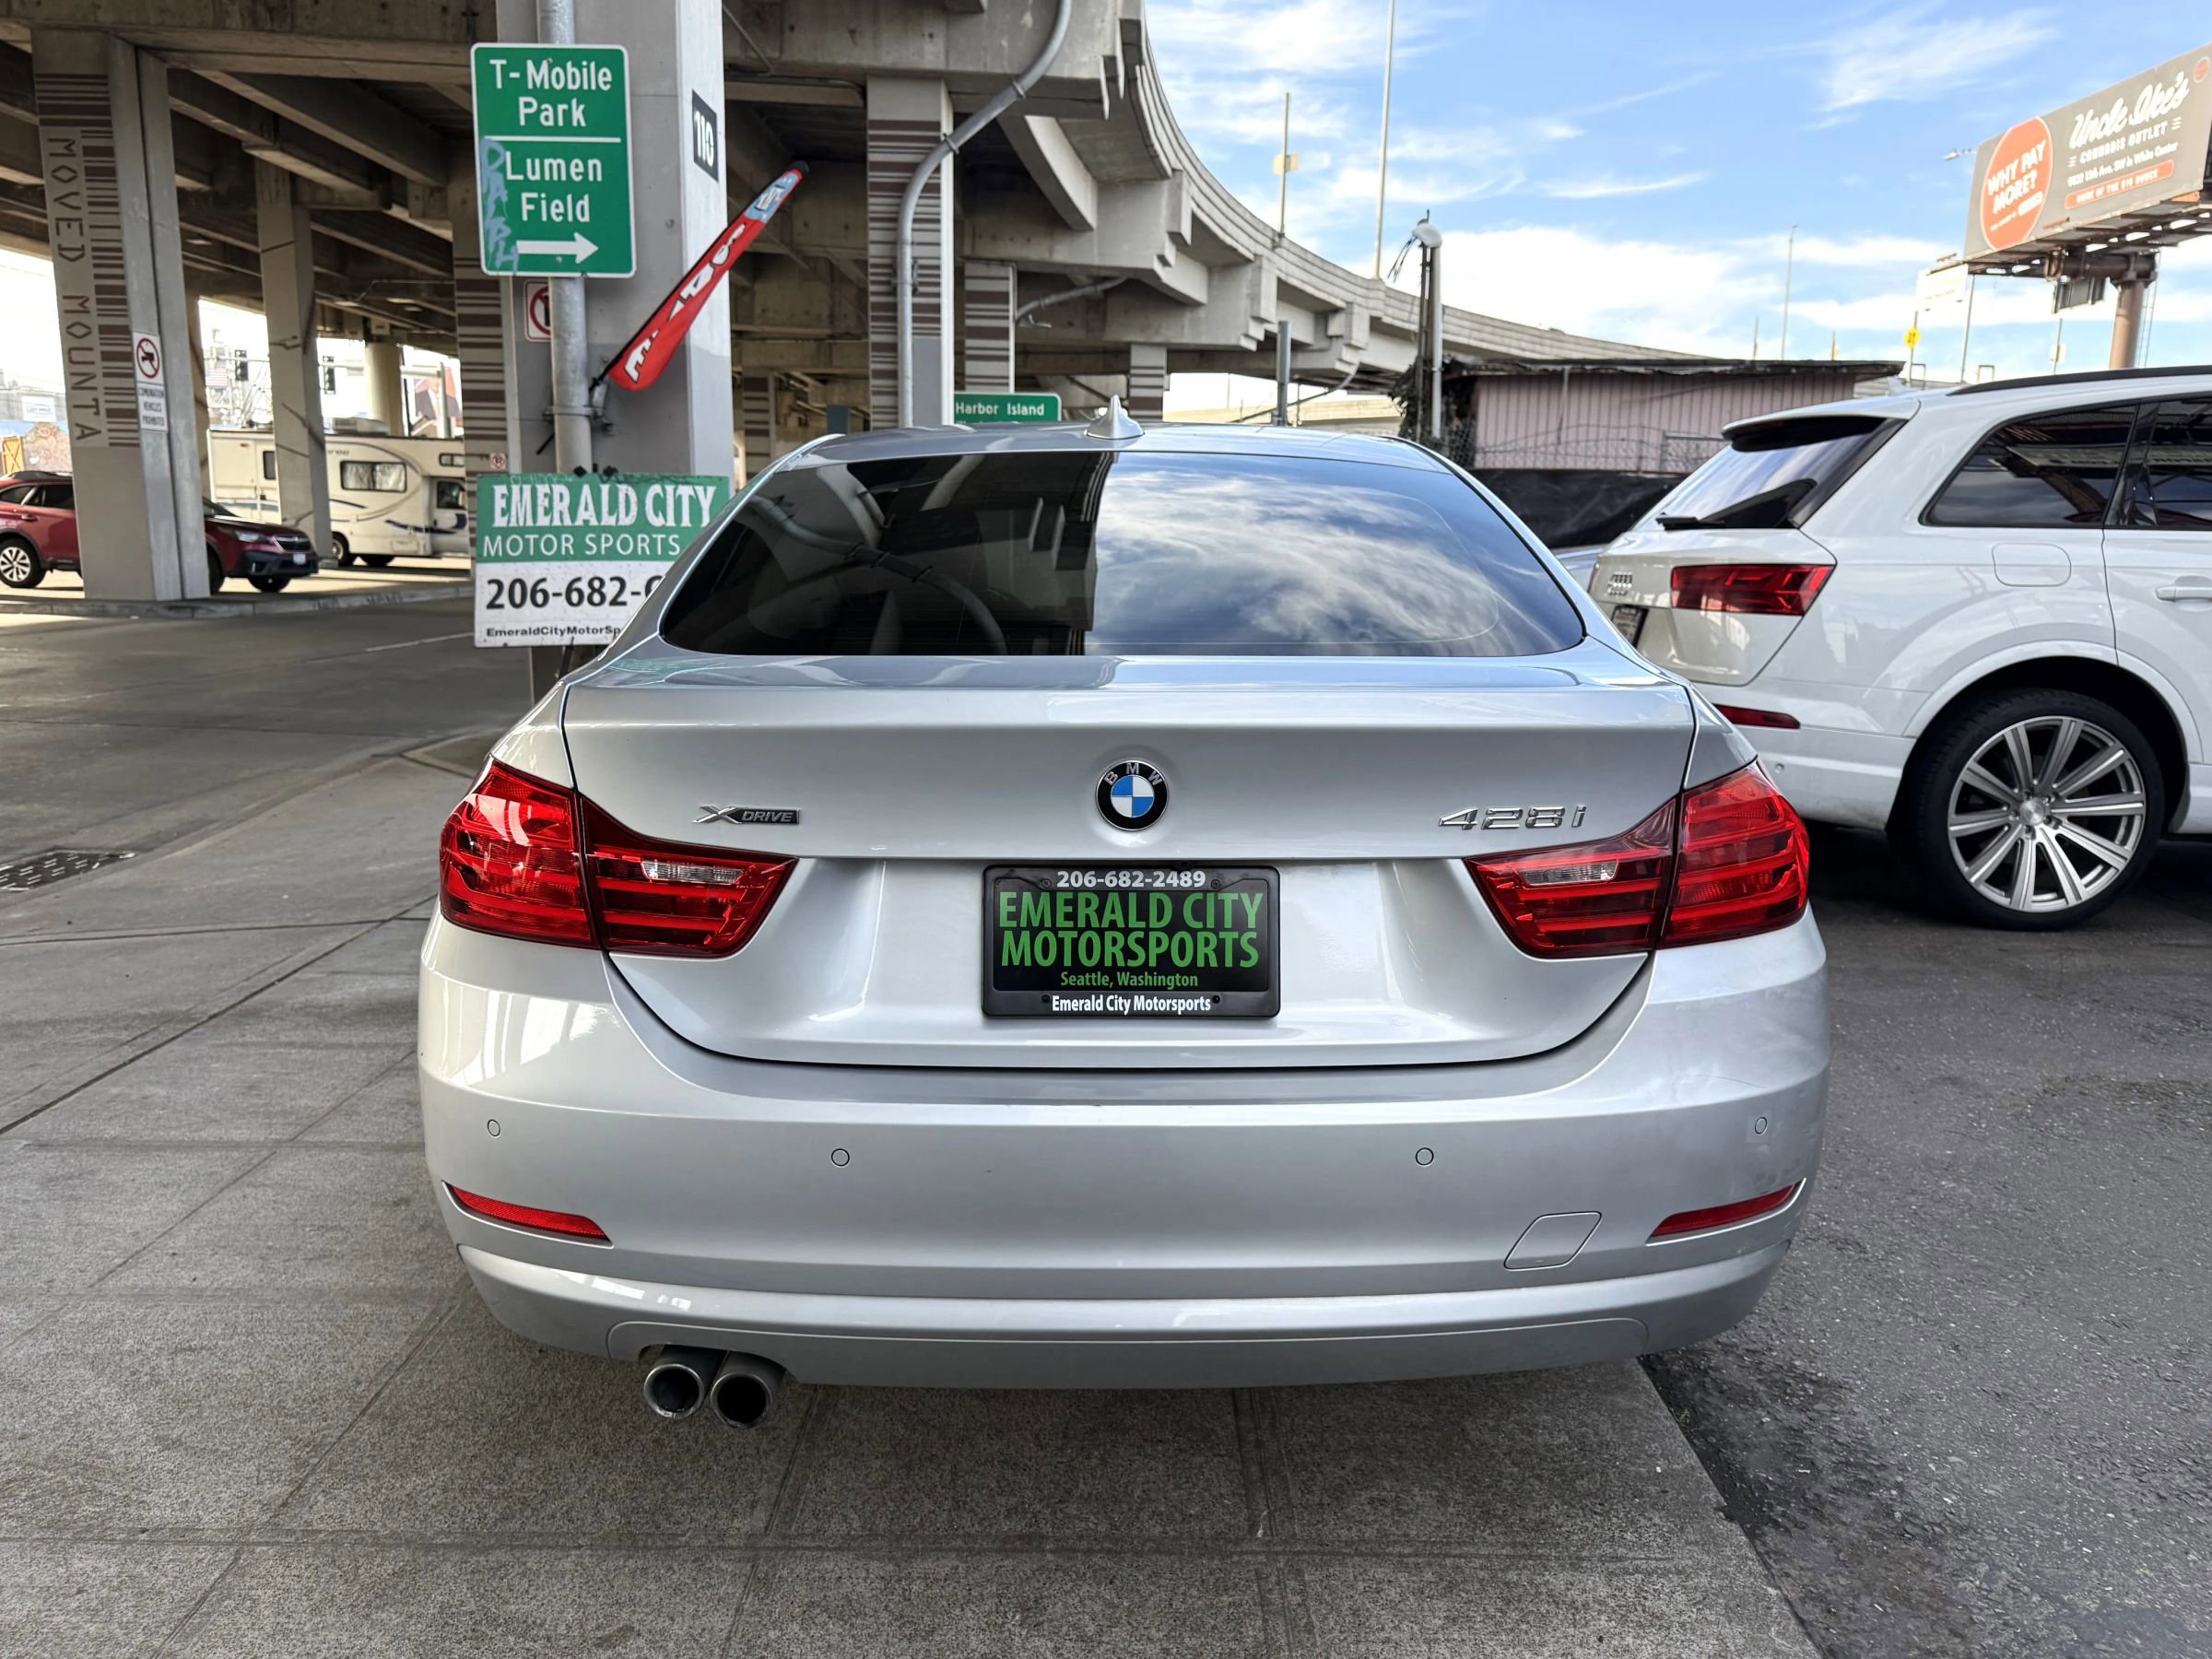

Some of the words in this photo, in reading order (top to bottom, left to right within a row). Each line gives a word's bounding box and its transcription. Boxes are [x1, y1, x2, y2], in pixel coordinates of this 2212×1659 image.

[489, 59, 612, 90] T-Mobile
[518, 97, 587, 127] Park
[2069, 97, 2128, 149] Uncle
[2127, 121, 2168, 147] OUTLET
[505, 151, 602, 182] Lumen
[1987, 159, 2019, 196] WHY
[2021, 139, 2046, 173] PAY
[47, 137, 86, 262] MOVED
[1993, 169, 2038, 214] MORE?
[521, 192, 590, 222] Field
[62, 295, 101, 441] MOUNTA
[955, 402, 999, 415] Harbor
[1007, 403, 1044, 416] Island
[492, 484, 639, 527] EMERALD
[645, 484, 717, 527] CITY
[483, 534, 574, 557] MOTOR
[585, 534, 680, 556] SPORTS
[1103, 762, 1163, 786] BMW
[1439, 803, 1587, 830] 428i
[1056, 870, 1206, 888] 206-682-2489
[999, 891, 1172, 928] EMERALD
[1183, 892, 1264, 928] CITY
[1001, 930, 1259, 968] MOTORSPORTS
[1060, 971, 1113, 988] Seattle,
[1116, 971, 1198, 990] Washington
[1052, 994, 1103, 1011] Emerald
[1106, 994, 1131, 1015] City
[1134, 994, 1211, 1015] Motorsports
